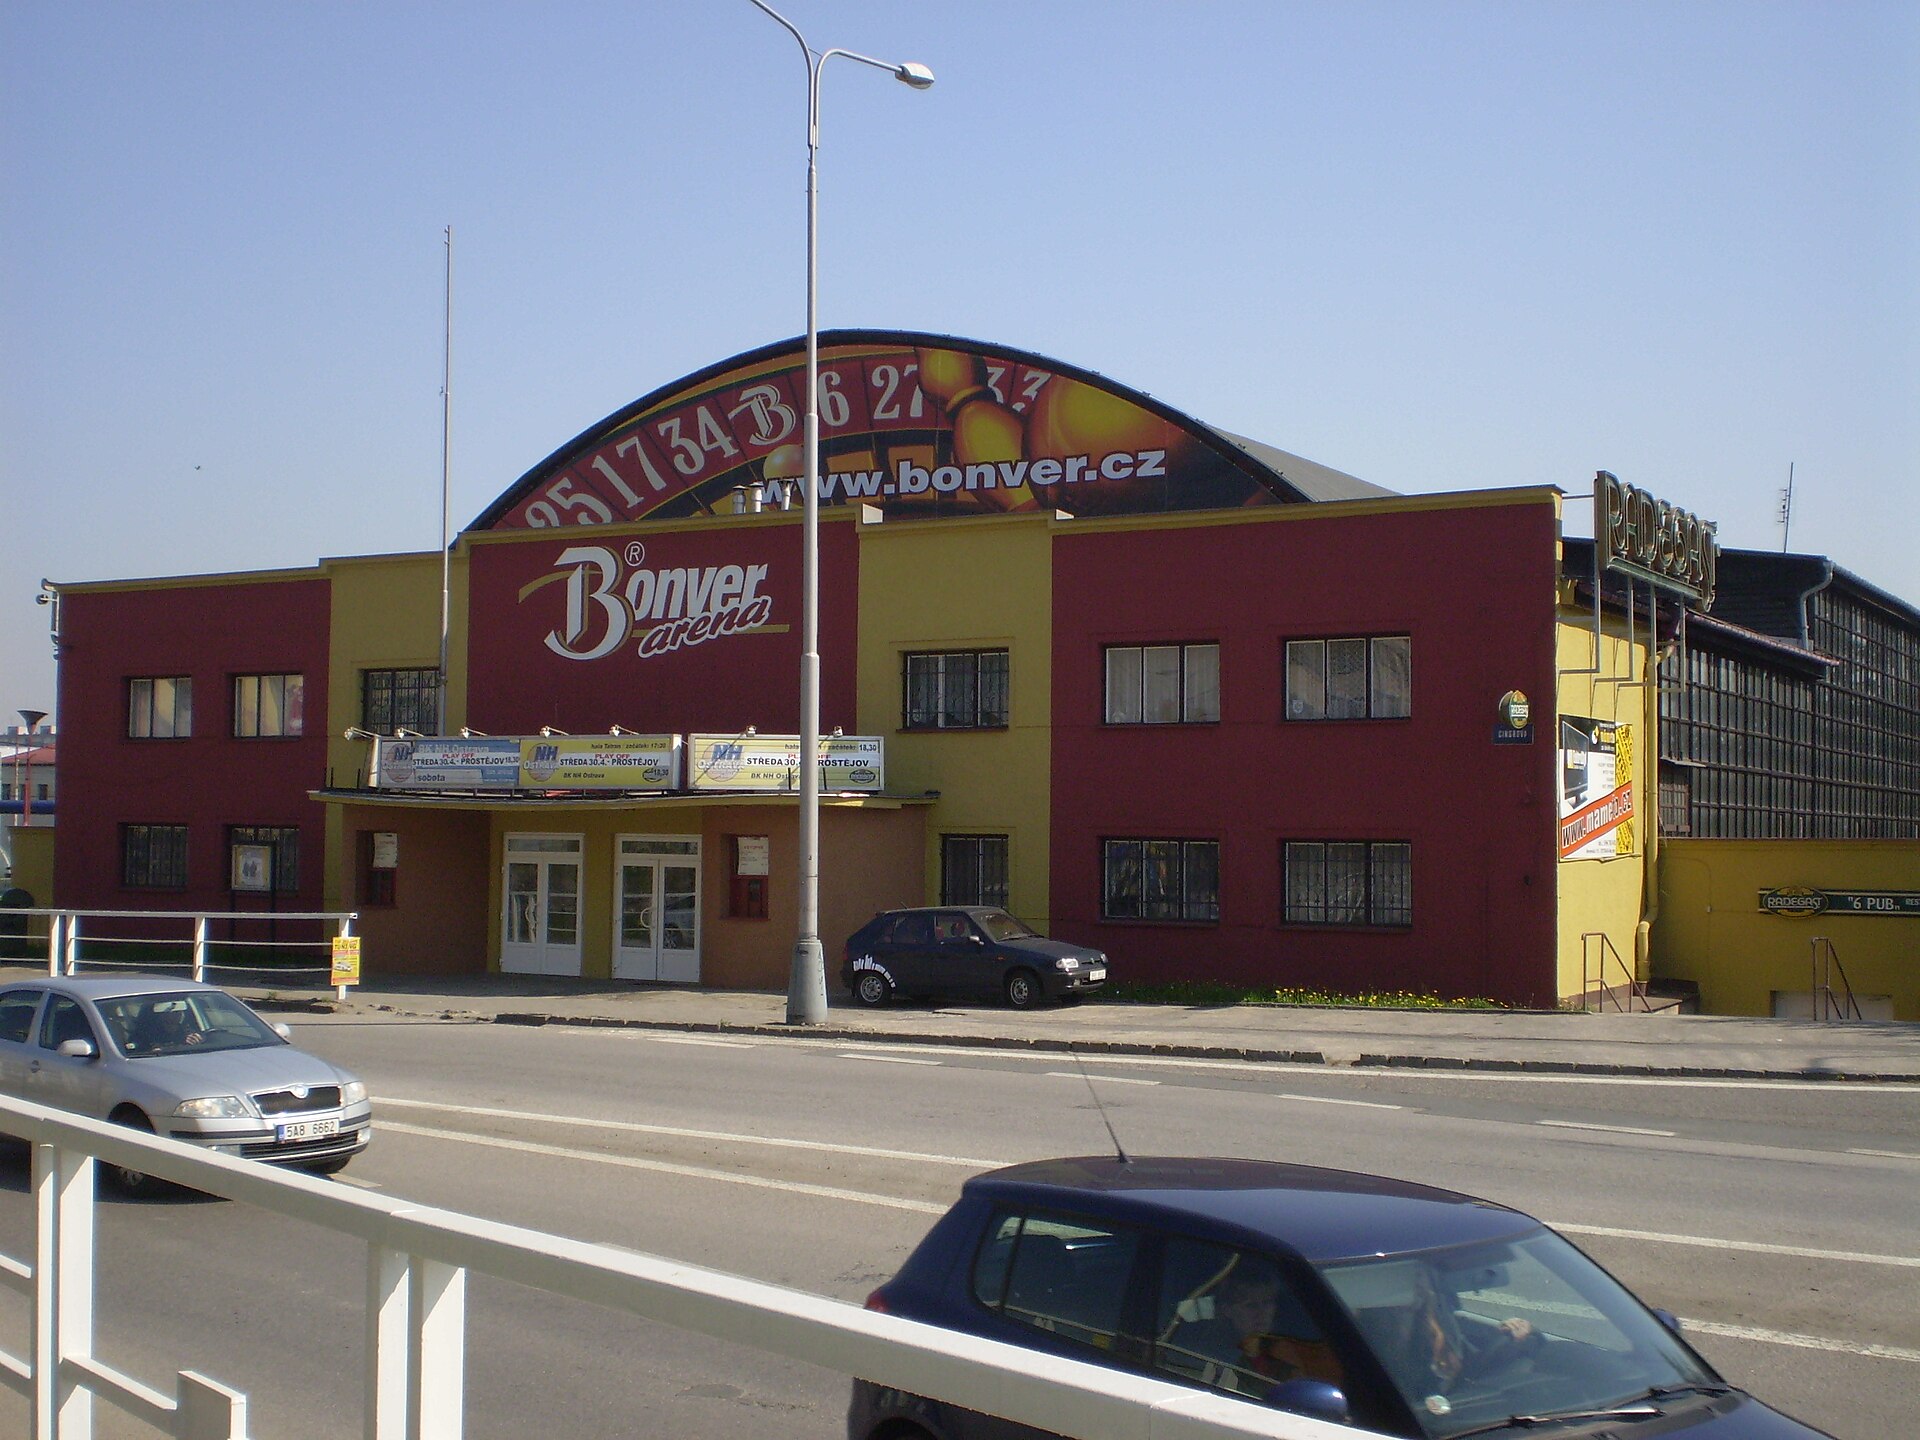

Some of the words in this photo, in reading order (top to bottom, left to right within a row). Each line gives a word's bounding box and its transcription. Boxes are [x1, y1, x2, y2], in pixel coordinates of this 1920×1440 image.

[592, 436, 666, 509] 17
[658, 406, 739, 474] 34
[727, 384, 796, 445] B
[817, 371, 850, 426] 6
[760, 450, 1166, 504] www.bonver.cz
[1596, 470, 1720, 613] RADEGAST
[544, 546, 768, 661] Bonver
[638, 595, 772, 659] arena
[711, 745, 743, 760] NH
[859, 744, 877, 752] 18,30
[560, 757, 587, 766] STŘEDA
[611, 757, 659, 767] PROSTĚJOV
[746, 757, 783, 766] STŘEDA
[417, 773, 446, 781] sobota
[1767, 896, 1823, 909] RADEGAST
[286, 1124, 305, 1138] 5A8
[312, 1121, 335, 1134] 6662
